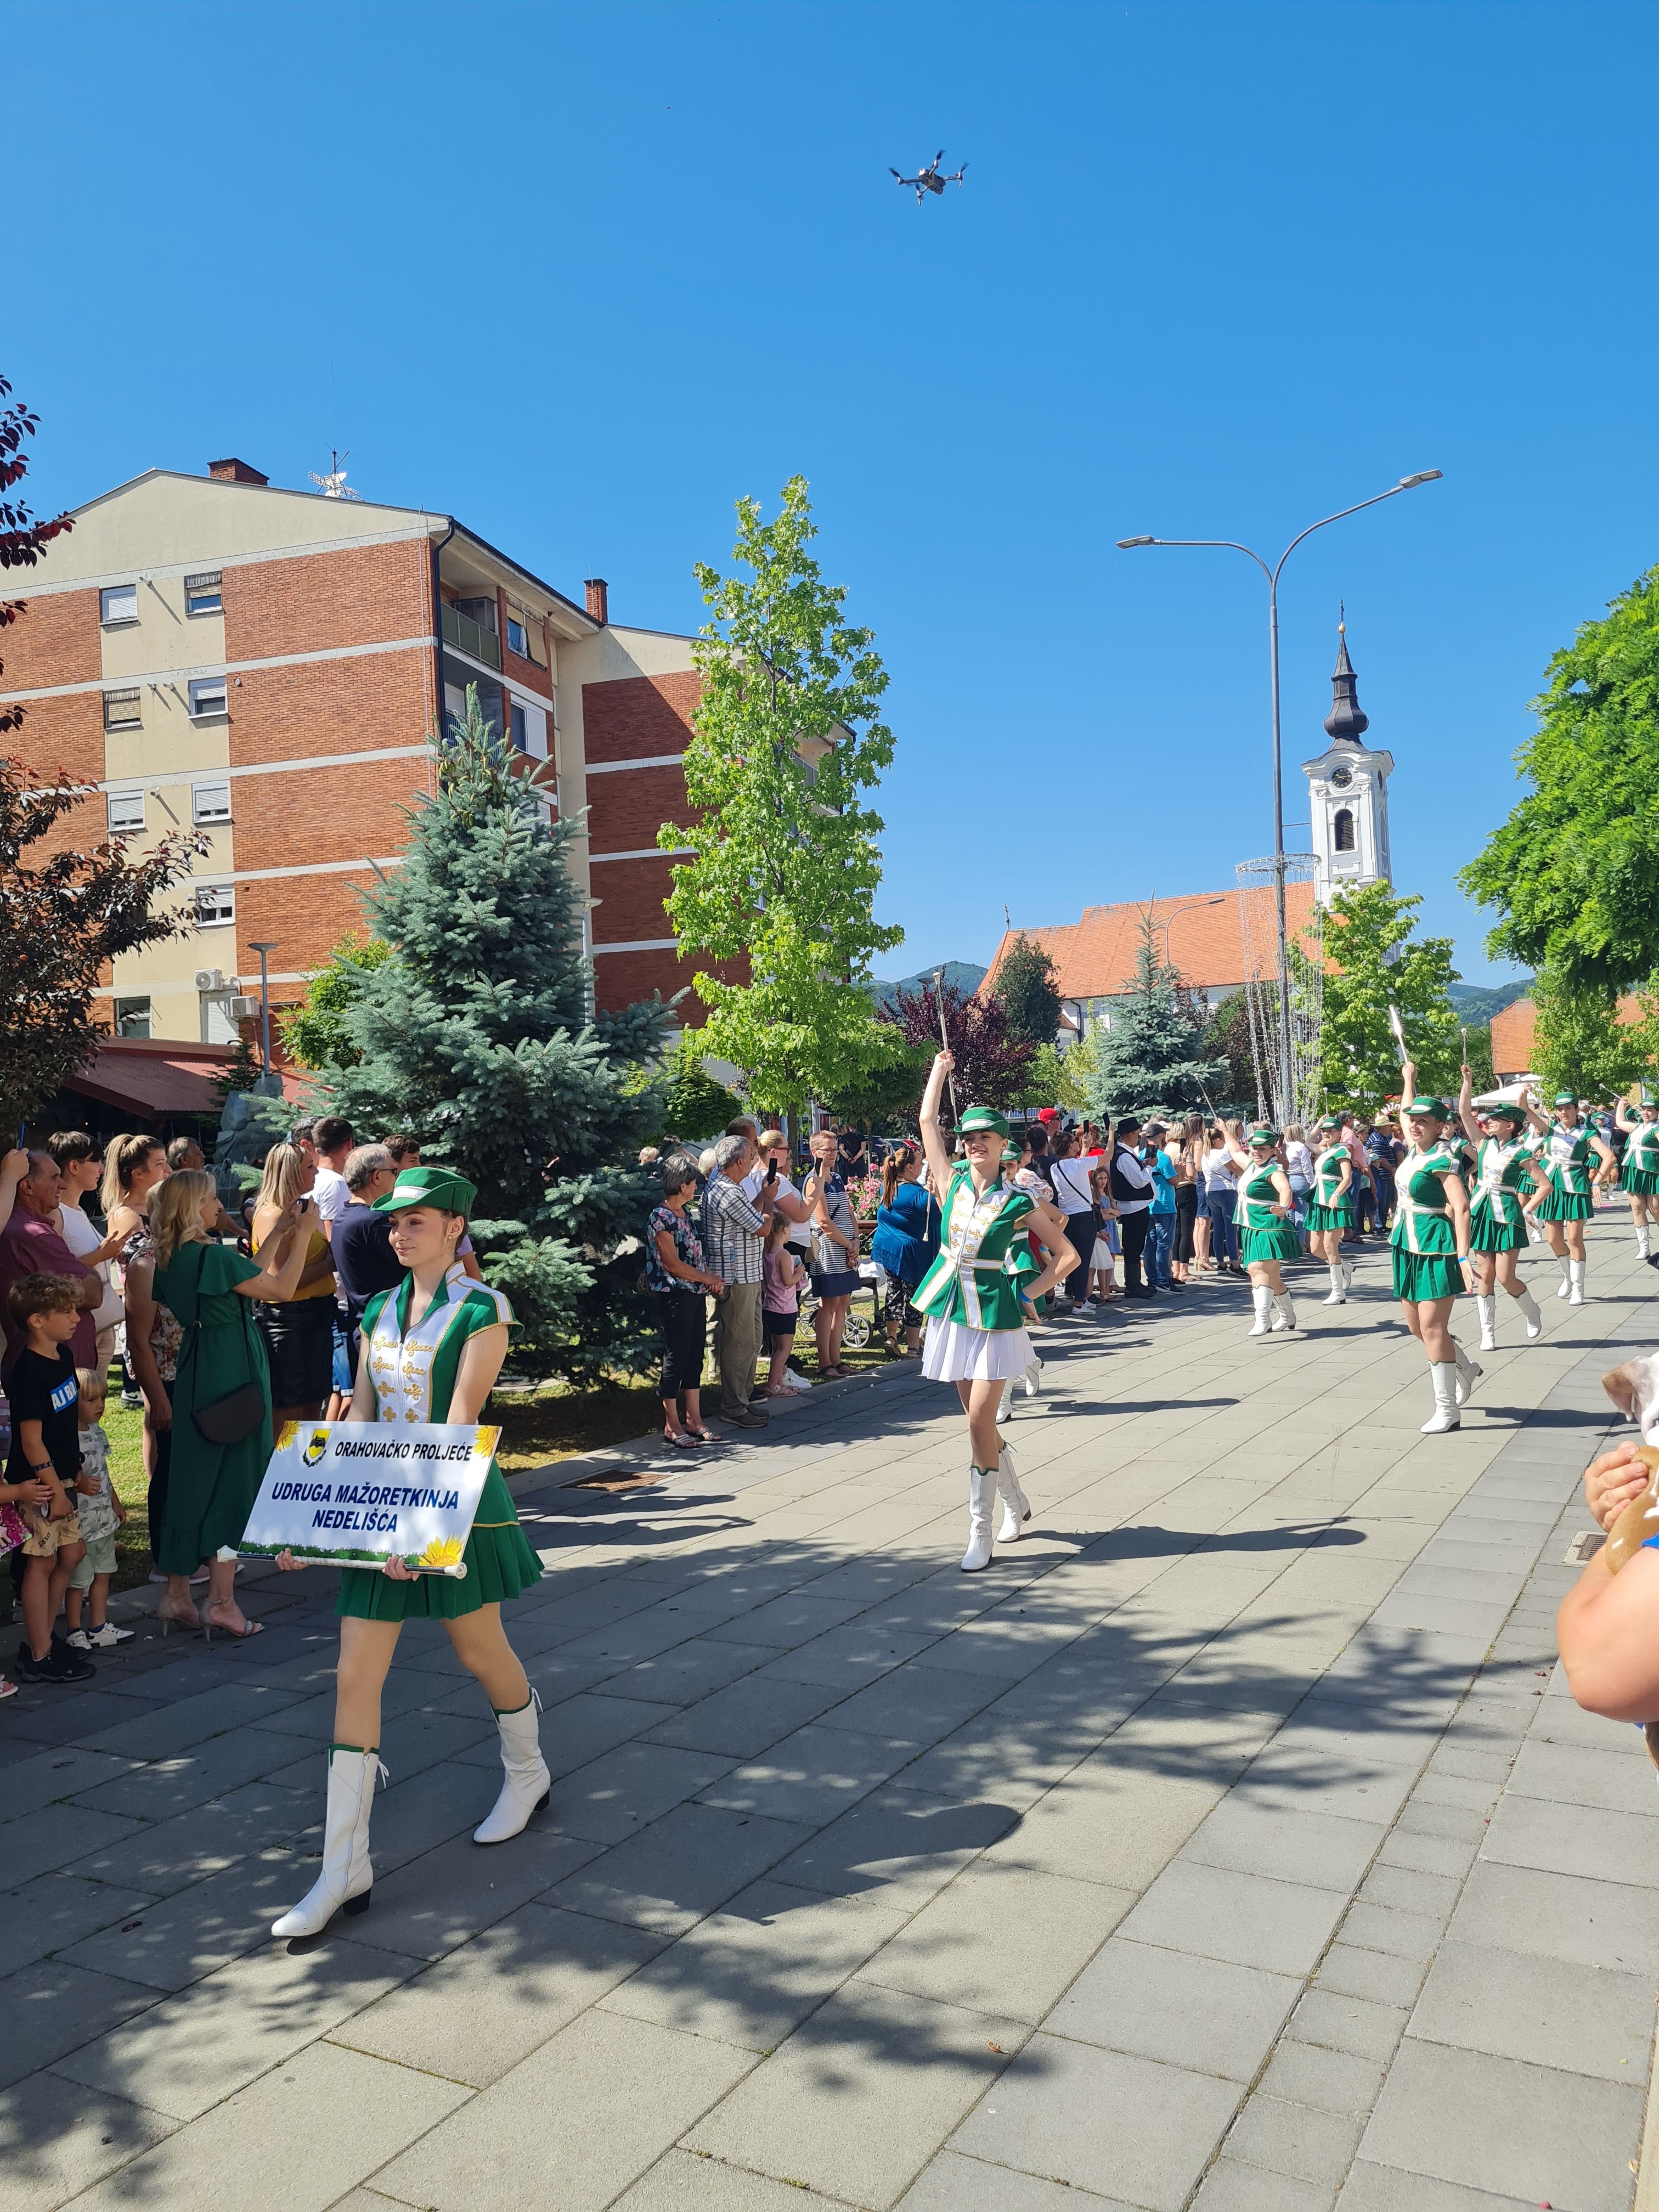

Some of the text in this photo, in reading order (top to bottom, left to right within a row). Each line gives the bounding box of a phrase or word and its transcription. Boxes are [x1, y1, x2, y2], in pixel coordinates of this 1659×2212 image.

[335, 1439, 473, 1461] ORAHOVAČKO PROLJEĆE
[272, 1481, 458, 1509] UDRUGA MAŽORETKINJA
[312, 1508, 398, 1532] NEDELIŠĆA
